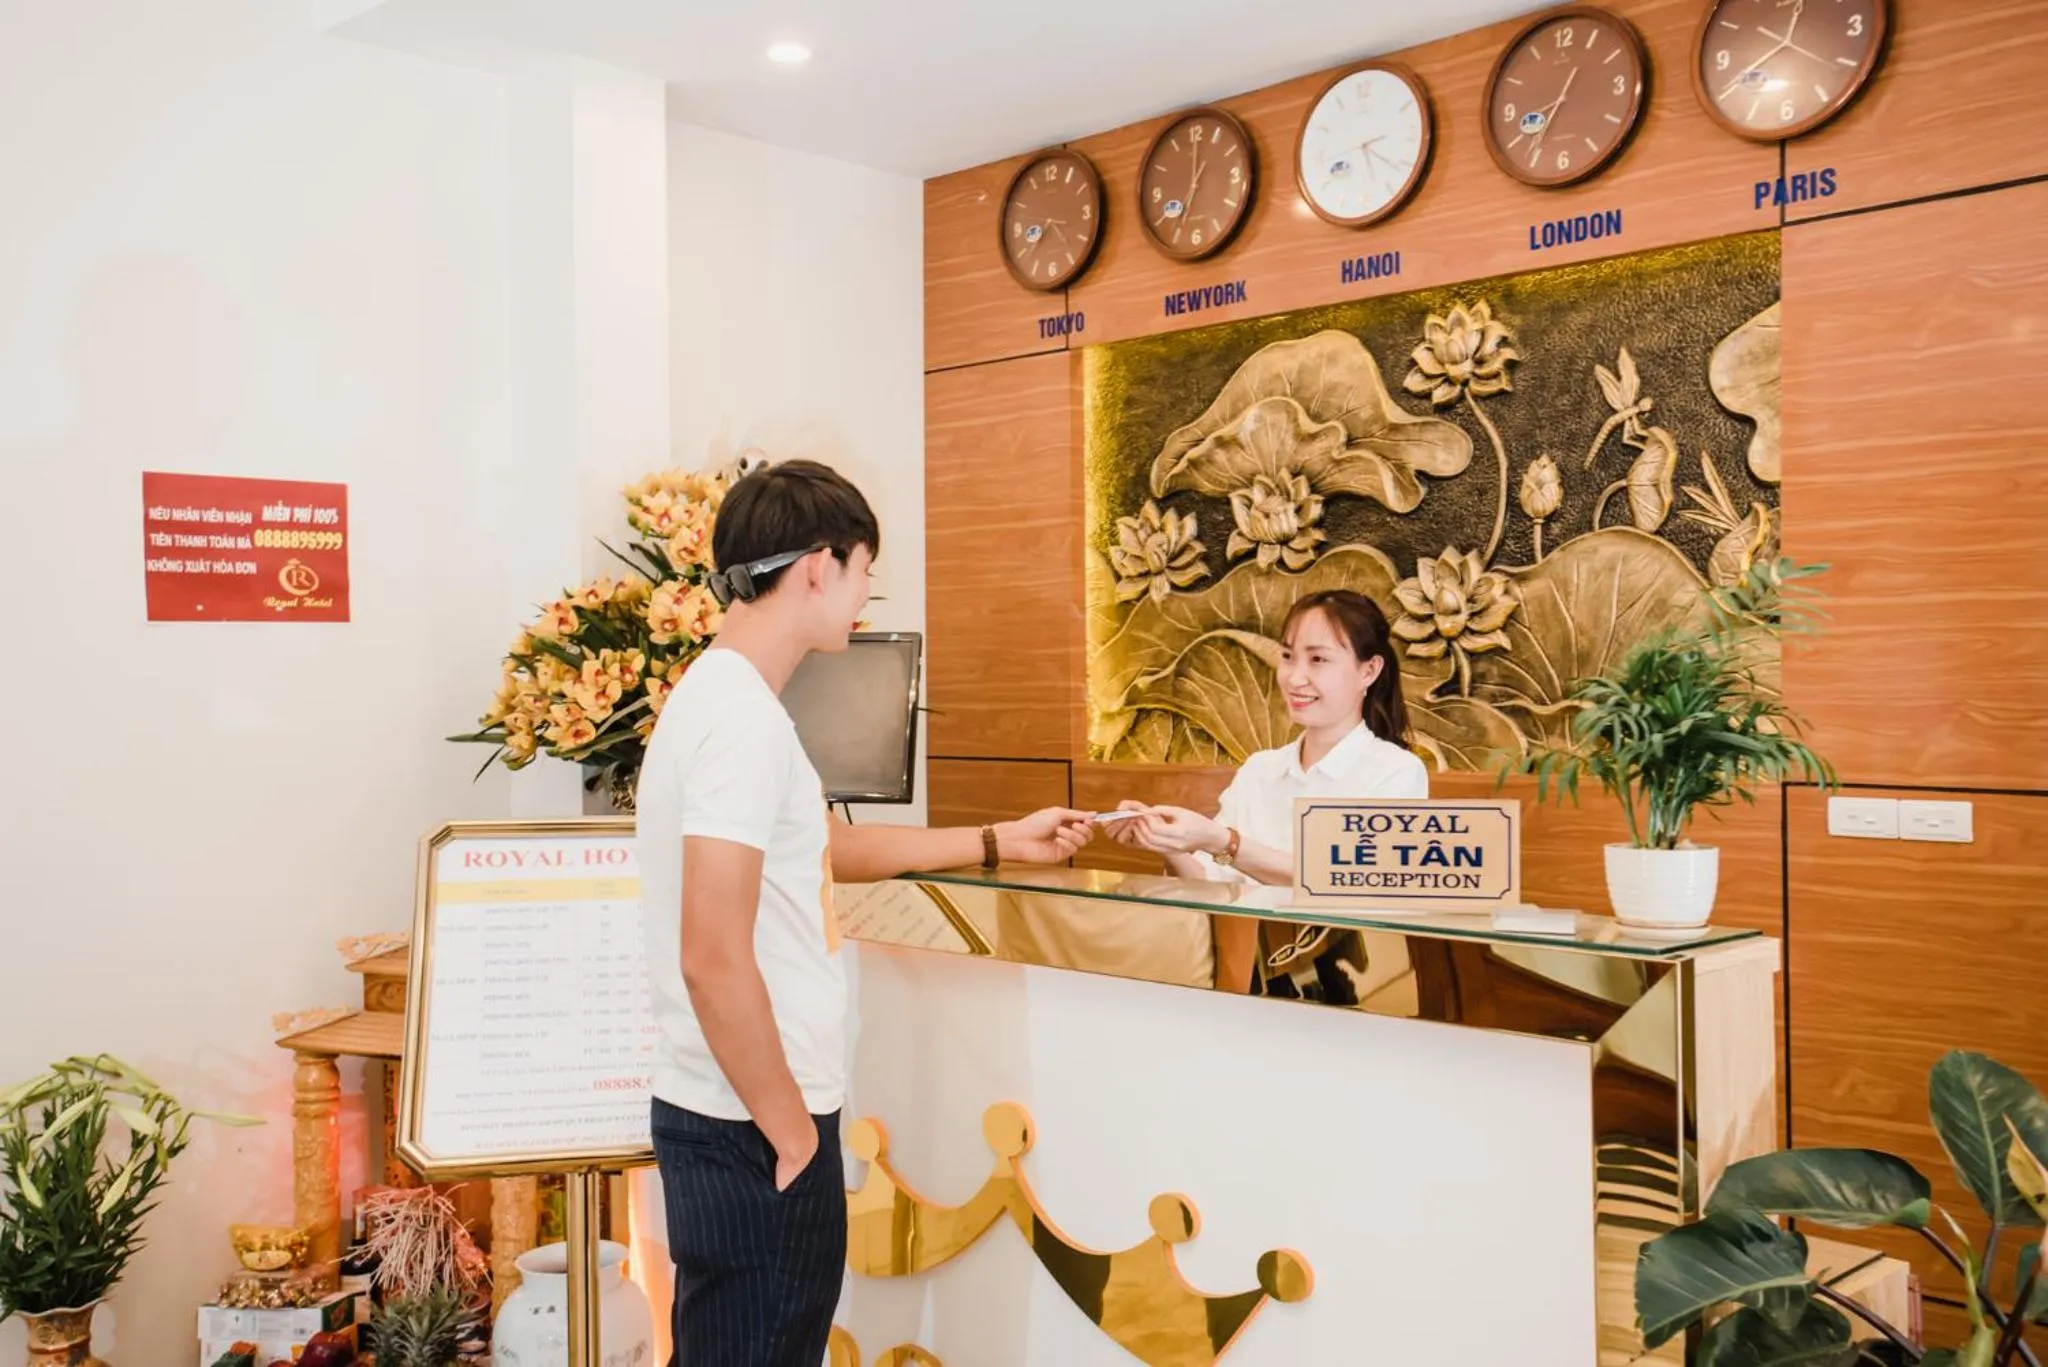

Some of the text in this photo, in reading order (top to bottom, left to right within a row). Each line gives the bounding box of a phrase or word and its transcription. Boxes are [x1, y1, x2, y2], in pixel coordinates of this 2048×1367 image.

[1847, 14, 1863, 36] 3
[1553, 27, 1573, 48] 12
[1716, 50, 1730, 70] 9
[1613, 75, 1624, 96] 3
[1504, 103, 1516, 122] 9
[1780, 100, 1794, 120] 6
[1189, 125, 1203, 143] 12
[1557, 151, 1569, 169] 6
[1045, 164, 1057, 181] 12
[1230, 167, 1240, 184] 3
[1152, 187, 1162, 203] 9
[1755, 168, 1837, 209] PARIS
[1082, 204, 1090, 220] 3
[1013, 222, 1022, 237] 9
[1191, 228, 1201, 245] 6
[1530, 209, 1622, 250] LONDON
[1048, 261, 1057, 277] 6
[1341, 251, 1400, 284] HANOI
[1164, 280, 1247, 317] NEWYORK
[1038, 311, 1084, 339] TOKYO
[174, 533, 207, 548] THANH
[1341, 813, 1470, 834] ROYAL
[463, 848, 630, 868] ROYAL HO
[1330, 833, 1484, 867] LỄ TÂN
[1329, 871, 1482, 889] RECEPTION
